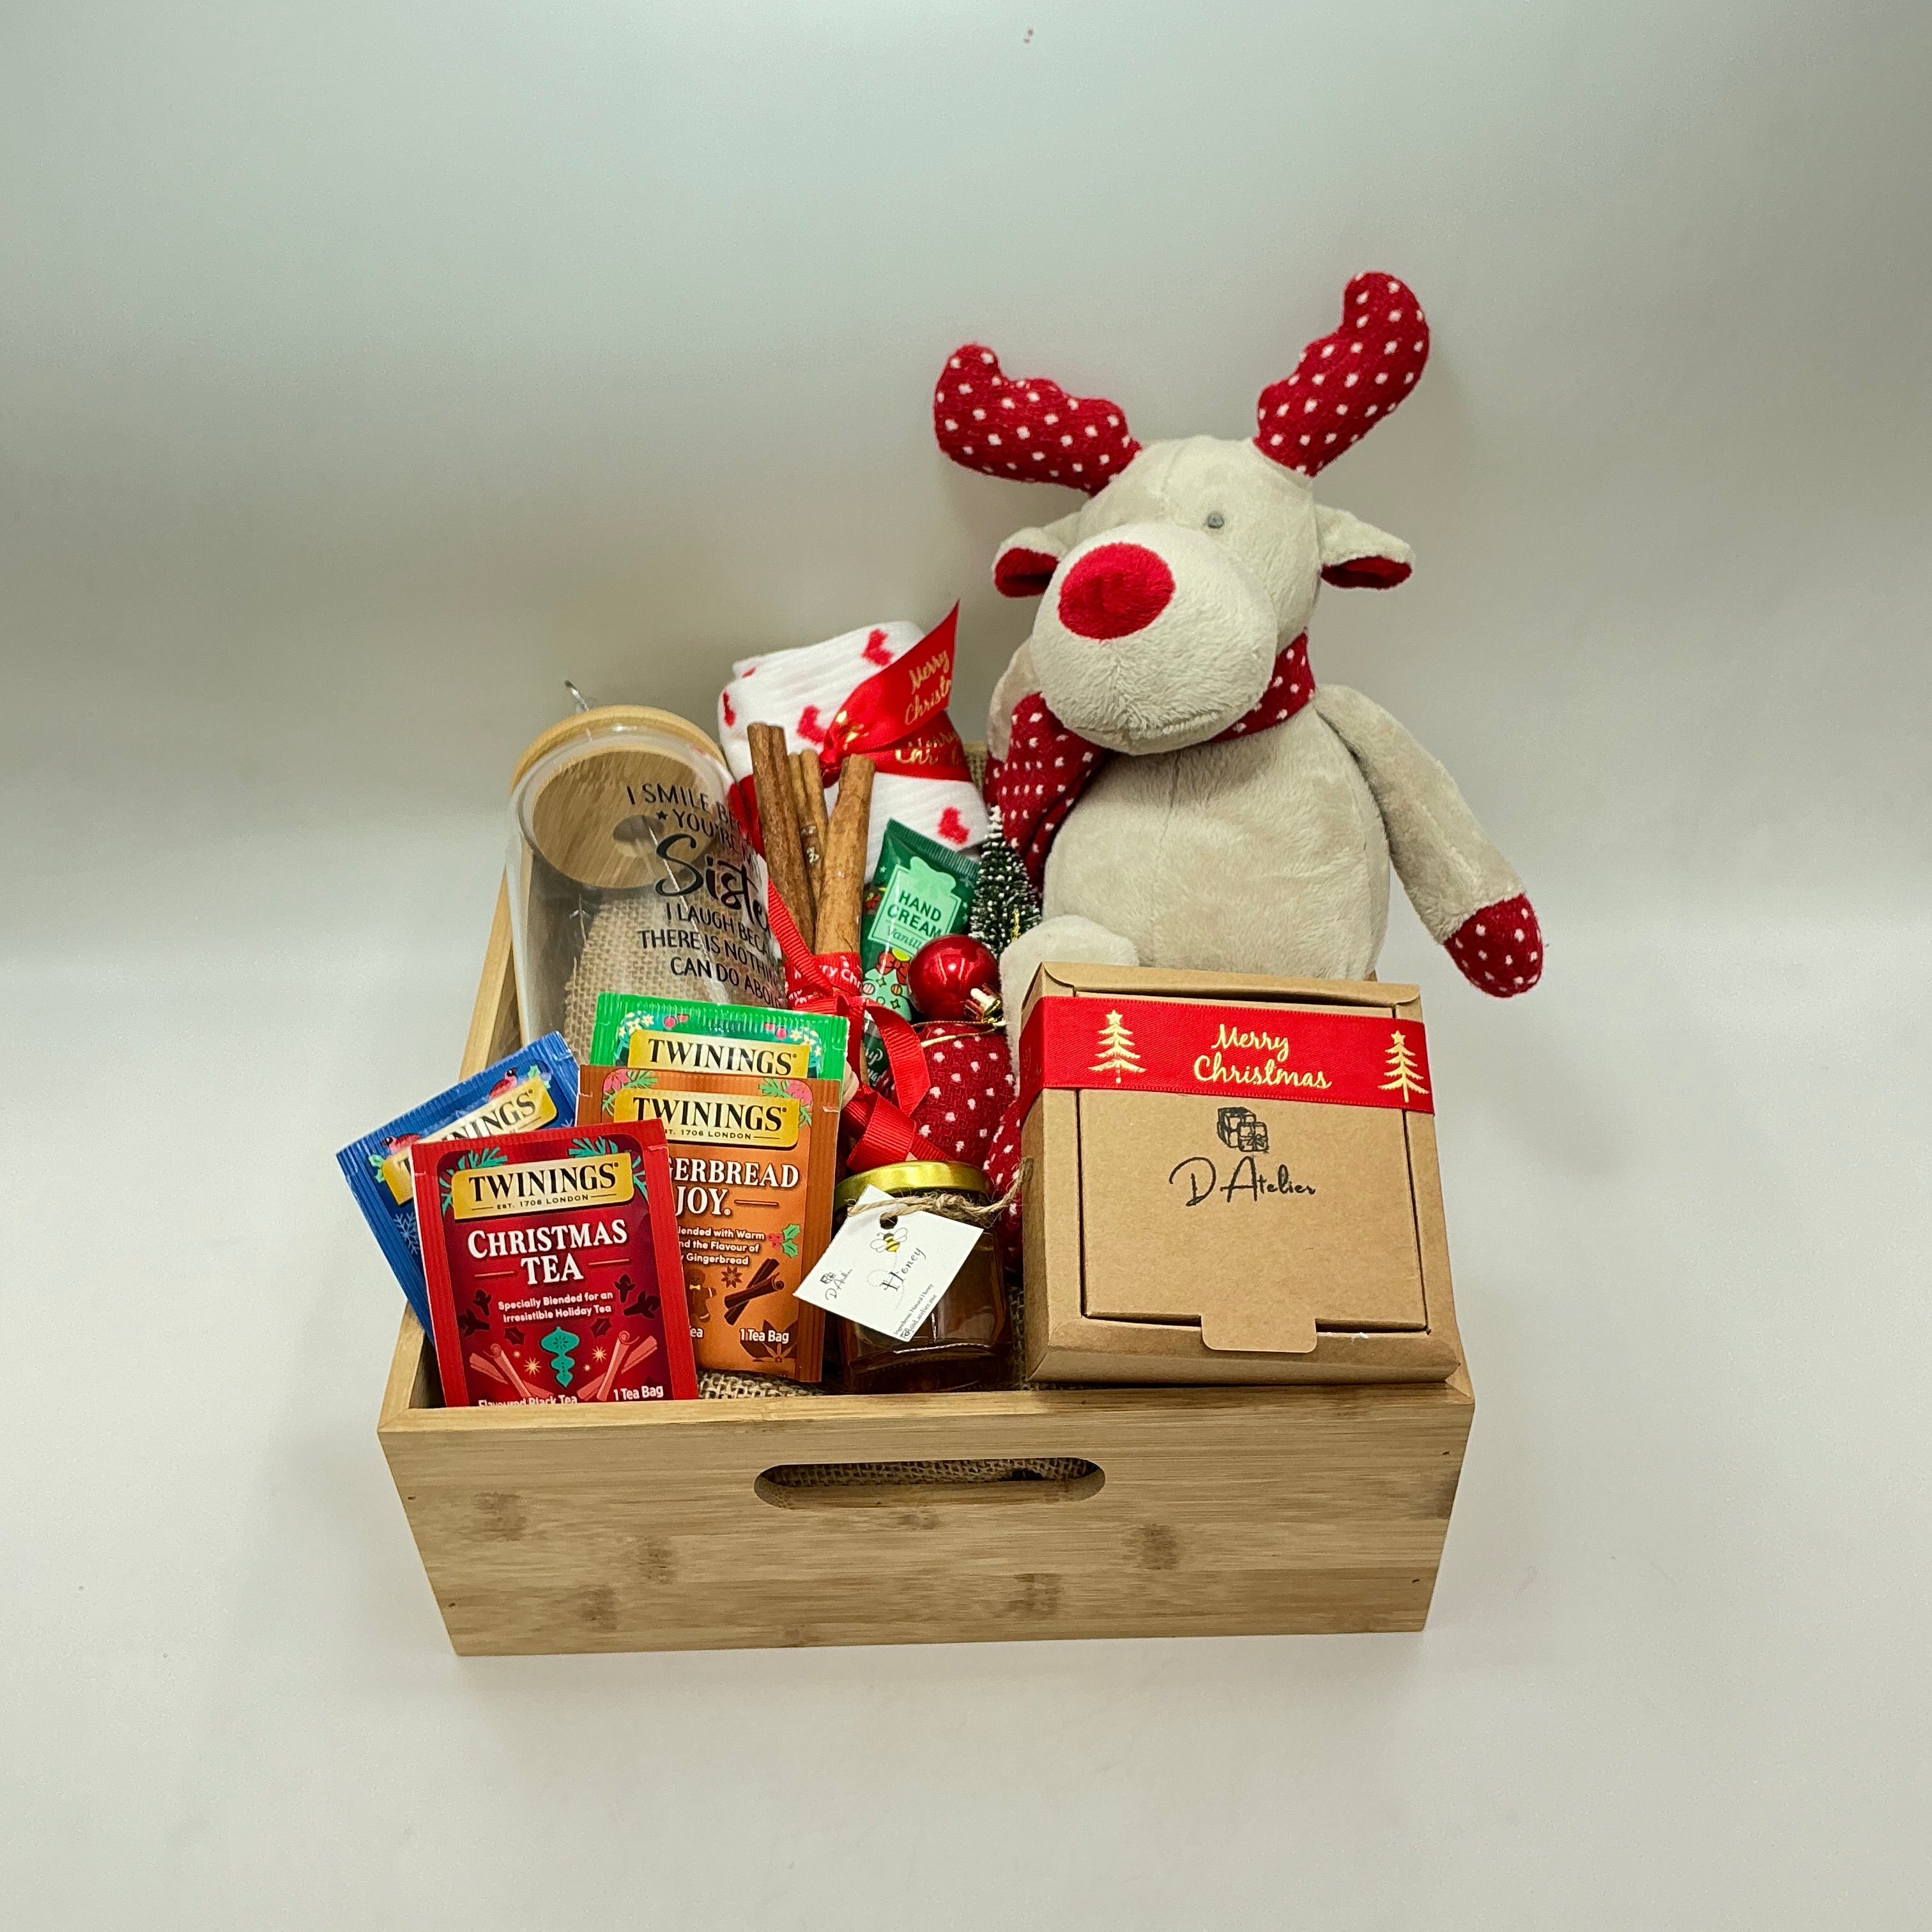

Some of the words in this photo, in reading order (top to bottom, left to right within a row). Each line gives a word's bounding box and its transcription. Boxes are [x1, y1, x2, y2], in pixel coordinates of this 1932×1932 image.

[627, 785, 636, 805] I
[642, 783, 709, 811] SMILE
[666, 902, 671, 920] I
[677, 903, 734, 935] LAUGH
[899, 889, 941, 923] HAND
[887, 904, 942, 938] CREAM
[638, 930, 700, 949] THERE
[705, 934, 721, 954] IS
[887, 924, 921, 950] Vanill
[670, 956, 712, 979] CAN
[717, 961, 739, 986] DO
[1211, 1023, 1289, 1061] Merry
[648, 1039, 792, 1076] TWININGS
[1193, 1052, 1332, 1090] Christmas
[633, 1097, 782, 1132] TWININGS
[708, 1131, 751, 1140] LONDON
[469, 1163, 617, 1202] TWININGS
[670, 1157, 799, 1188] ERBREAD
[519, 1199, 542, 1208] 1706
[546, 1194, 589, 1205] LONDON
[468, 1219, 627, 1259] CHRISTMAS
[678, 1226, 712, 1237] lended
[714, 1229, 734, 1238] with
[736, 1229, 765, 1240] Warm
[693, 1240, 708, 1249] the
[710, 1241, 747, 1252] Flavour
[749, 1244, 760, 1252] of
[521, 1253, 584, 1285] TEA
[686, 1253, 749, 1265] Gingerbread
[879, 1247, 926, 1292] Honey
[498, 1298, 541, 1312] Specially
[543, 1293, 583, 1306] Blended
[584, 1292, 599, 1301] for
[503, 1310, 553, 1322] Irresistible
[555, 1307, 592, 1318] Holiday
[593, 1305, 611, 1314] Tea
[689, 1325, 703, 1338] ea
[740, 1328, 745, 1340] 1
[747, 1329, 765, 1342] Tea
[768, 1330, 790, 1344] Bag
[558, 1394, 578, 1404] Tea
[613, 1389, 619, 1400] 1
[620, 1388, 640, 1400] Tea
[641, 1385, 664, 1398] Bag
